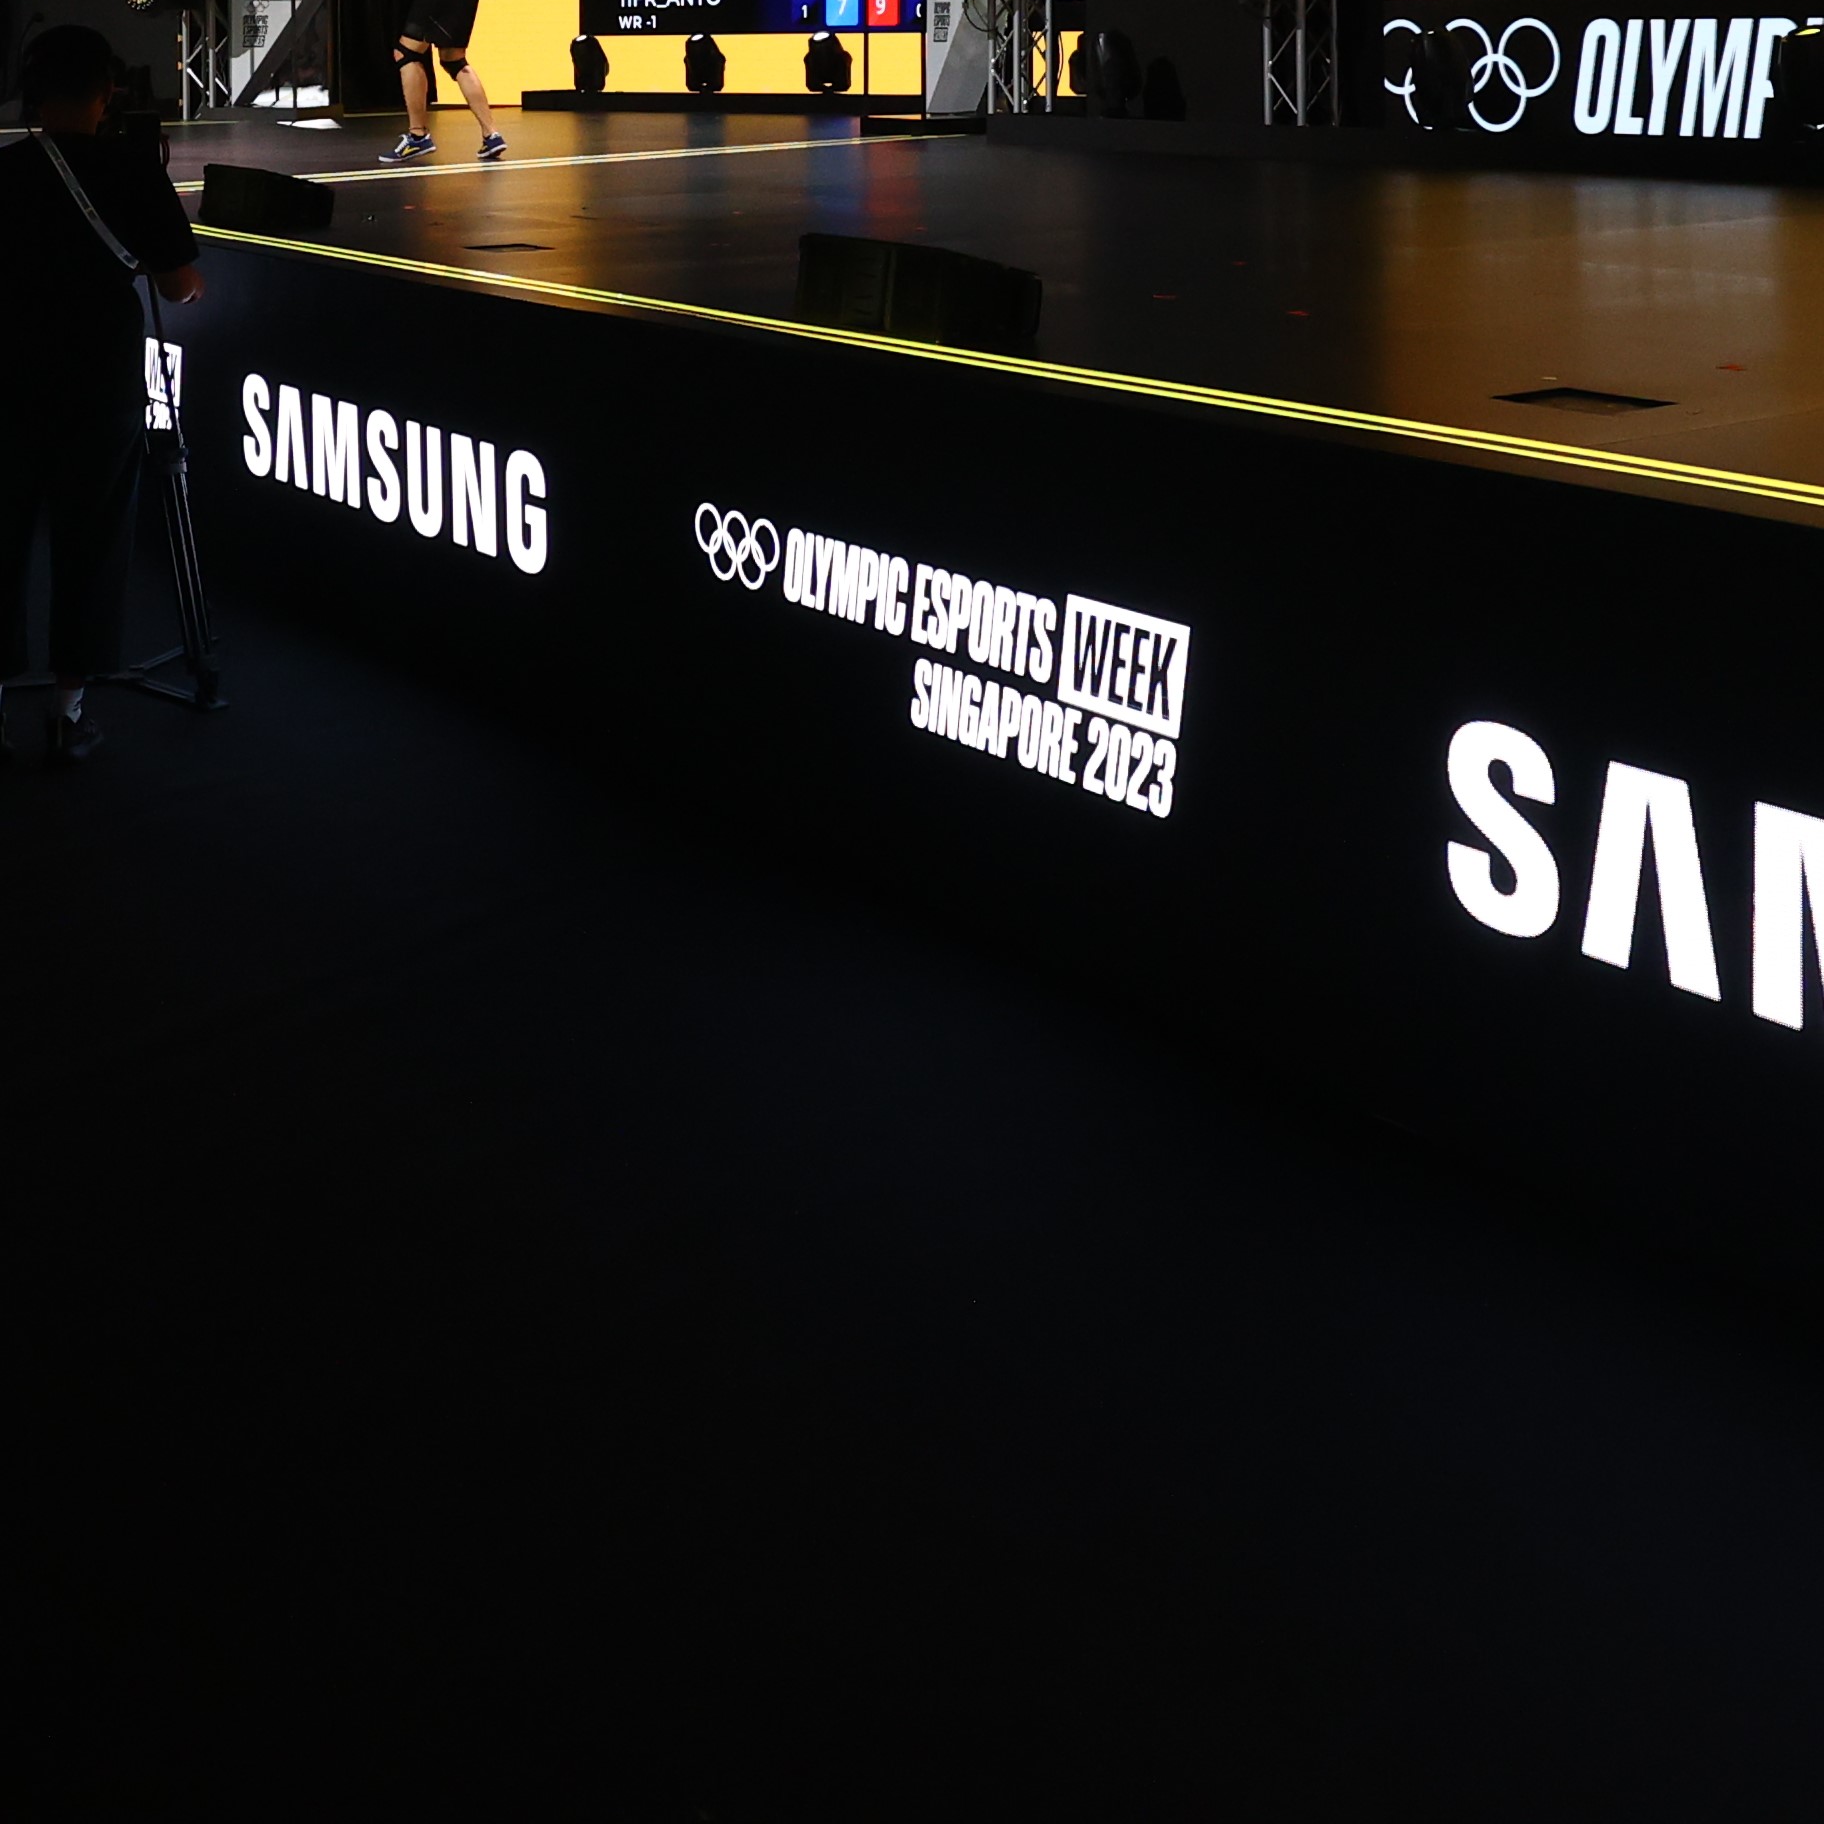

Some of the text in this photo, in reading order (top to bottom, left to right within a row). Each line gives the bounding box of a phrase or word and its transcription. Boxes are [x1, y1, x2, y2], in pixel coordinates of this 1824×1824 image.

[618, 15, 657, 29] WR -1
[801, 5, 808, 18] 1
[242, 373, 548, 575] SAMSUNG
[782, 526, 1178, 722] OLYMPIC ESPORTS WEEK
[911, 658, 1176, 819] SINGAPORE 2023
